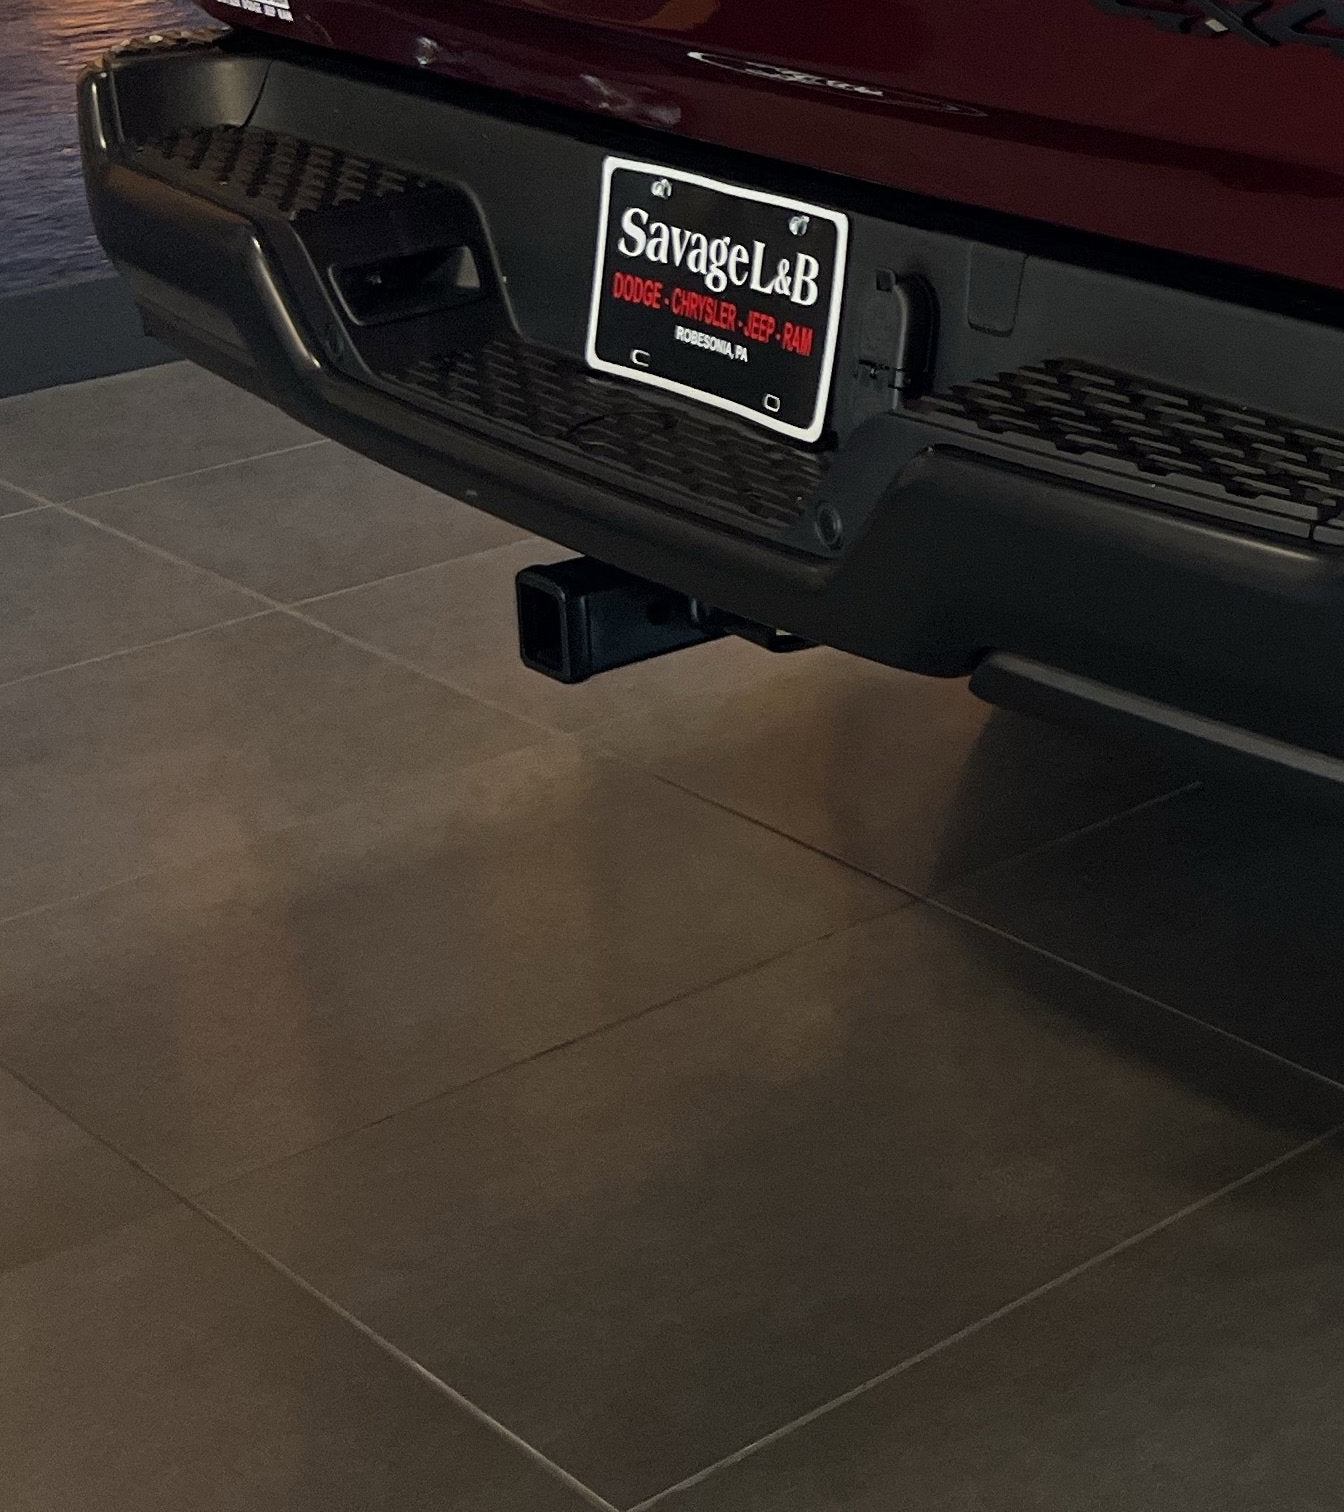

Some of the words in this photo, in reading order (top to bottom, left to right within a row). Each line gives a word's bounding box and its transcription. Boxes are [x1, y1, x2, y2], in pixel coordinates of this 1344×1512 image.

[613, 272, 662, 310] DODGE
[671, 288, 737, 331] CHRYSLER
[744, 310, 776, 343] JEEP
[784, 322, 813, 357] RAM
